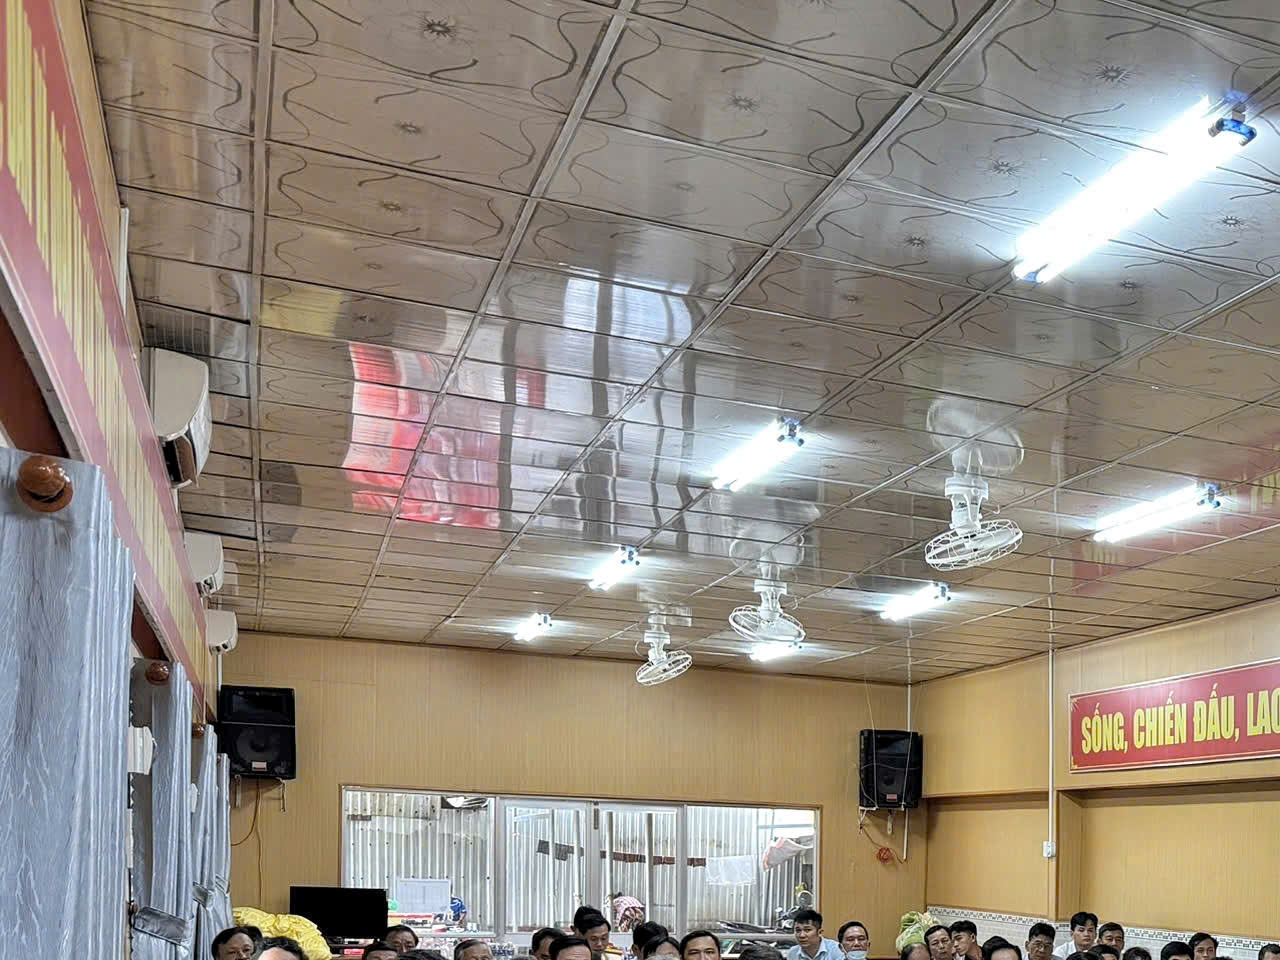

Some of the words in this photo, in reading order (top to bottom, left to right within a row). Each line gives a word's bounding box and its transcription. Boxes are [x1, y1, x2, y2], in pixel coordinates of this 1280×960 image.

[1081, 702, 1128, 754] SỐNG,
[1133, 690, 1187, 749] CHIẾN
[1193, 682, 1240, 743] ĐẤU,
